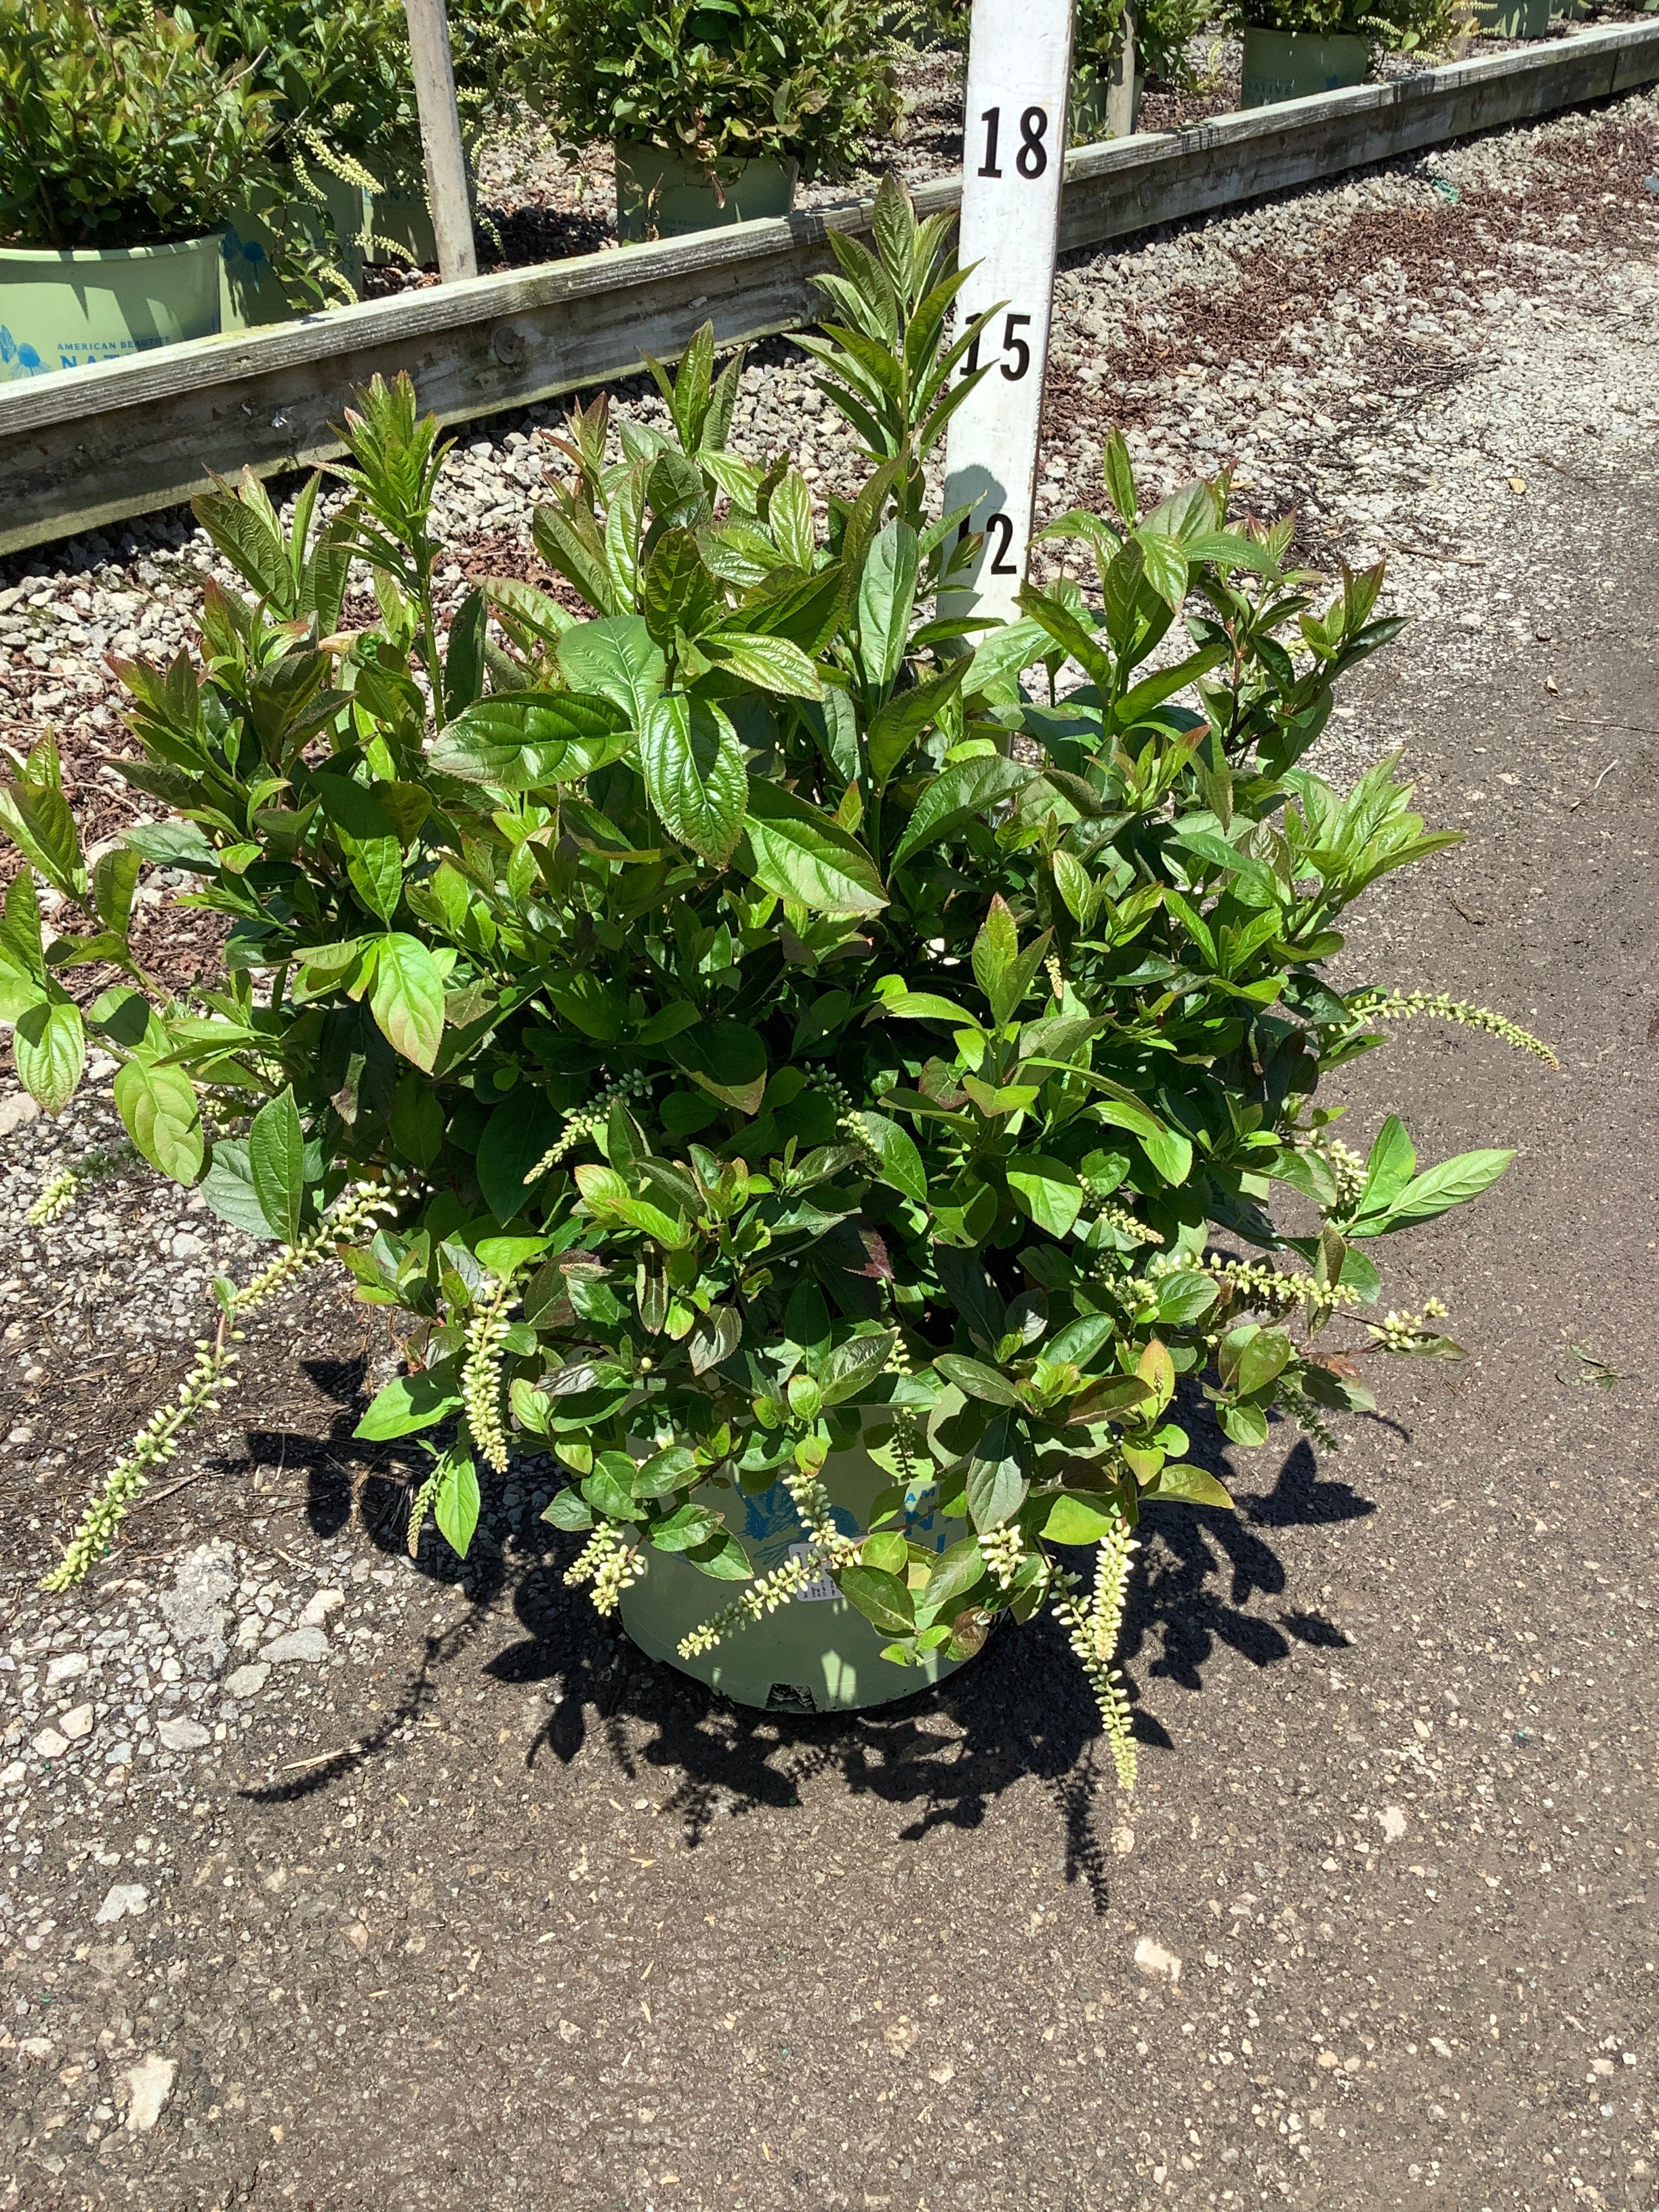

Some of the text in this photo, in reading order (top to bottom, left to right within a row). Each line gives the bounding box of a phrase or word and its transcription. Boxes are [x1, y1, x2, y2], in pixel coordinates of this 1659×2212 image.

[978, 106, 1048, 180] 18
[57, 342, 116, 350] AMERICAN
[960, 312, 1031, 381] 15
